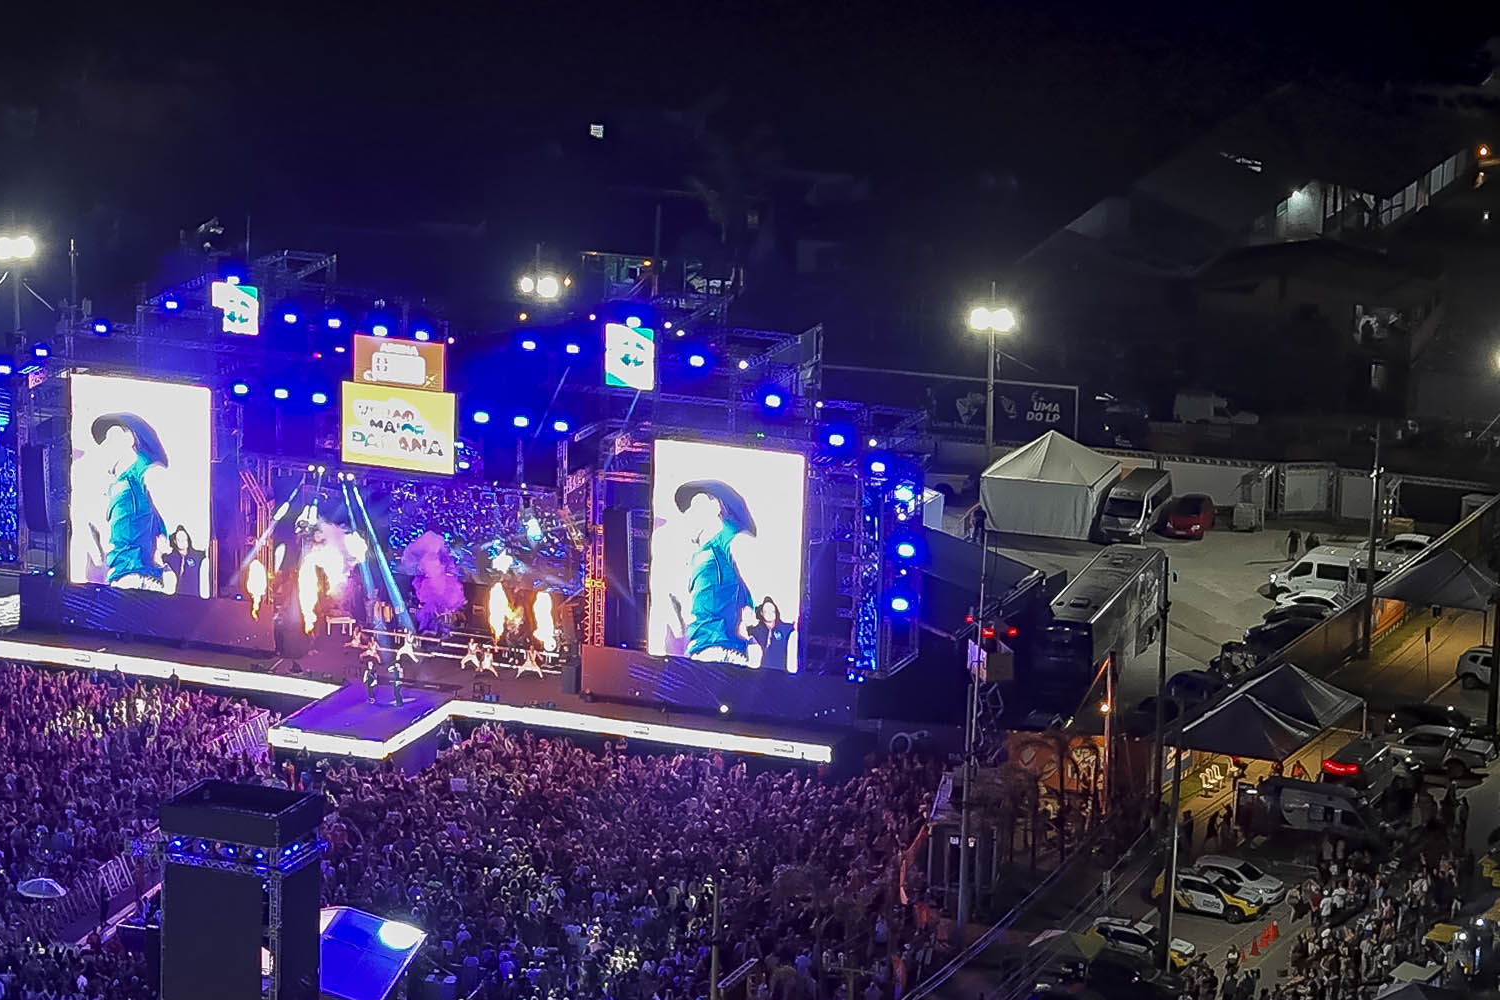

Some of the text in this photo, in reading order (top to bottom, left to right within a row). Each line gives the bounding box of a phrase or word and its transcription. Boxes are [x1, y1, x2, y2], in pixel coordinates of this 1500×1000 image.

[1033, 401, 1060, 413] UMA
[1026, 411, 1061, 423] DO LP
